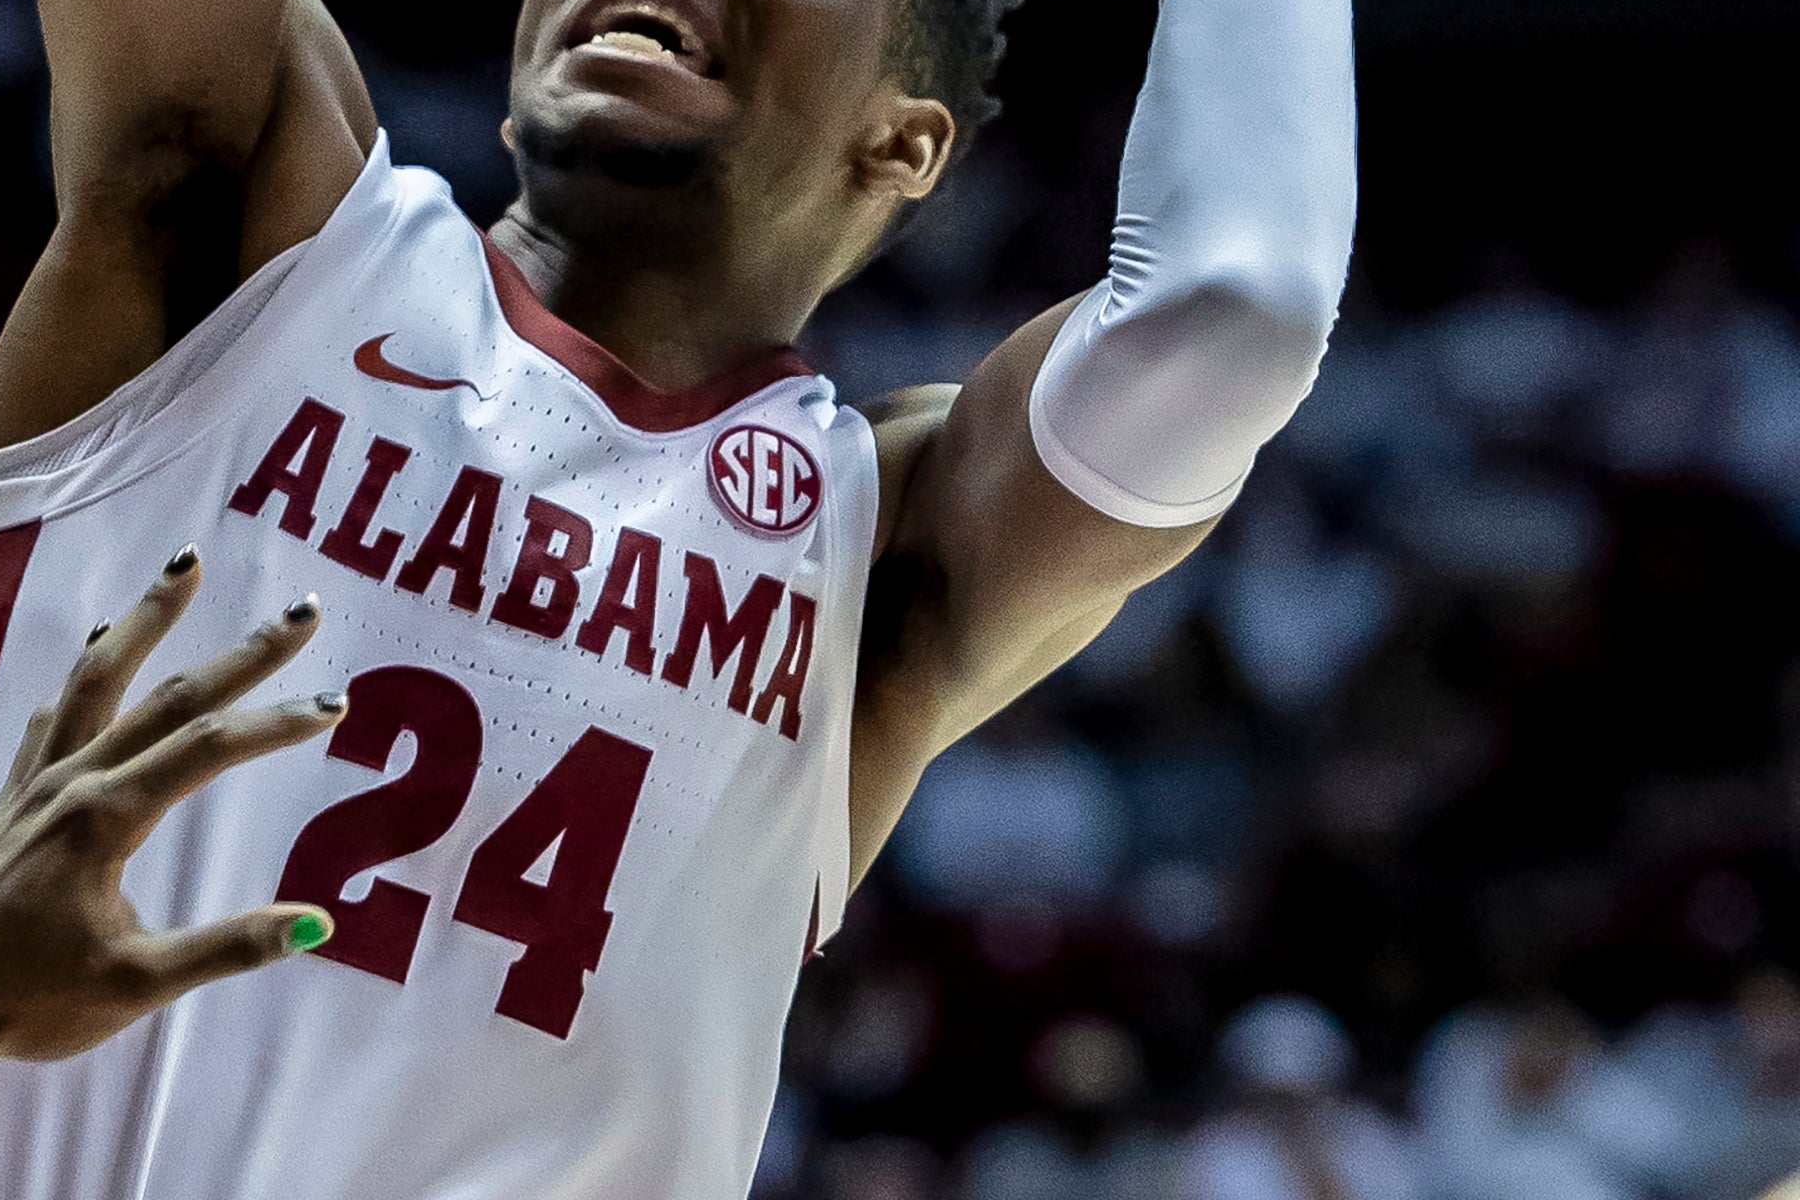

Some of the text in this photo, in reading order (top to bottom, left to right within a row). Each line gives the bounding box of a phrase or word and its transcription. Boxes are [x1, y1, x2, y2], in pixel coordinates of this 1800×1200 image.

[227, 396, 818, 742] ALABAMA
[717, 428, 814, 528] SEC
[272, 664, 653, 1040] 24
